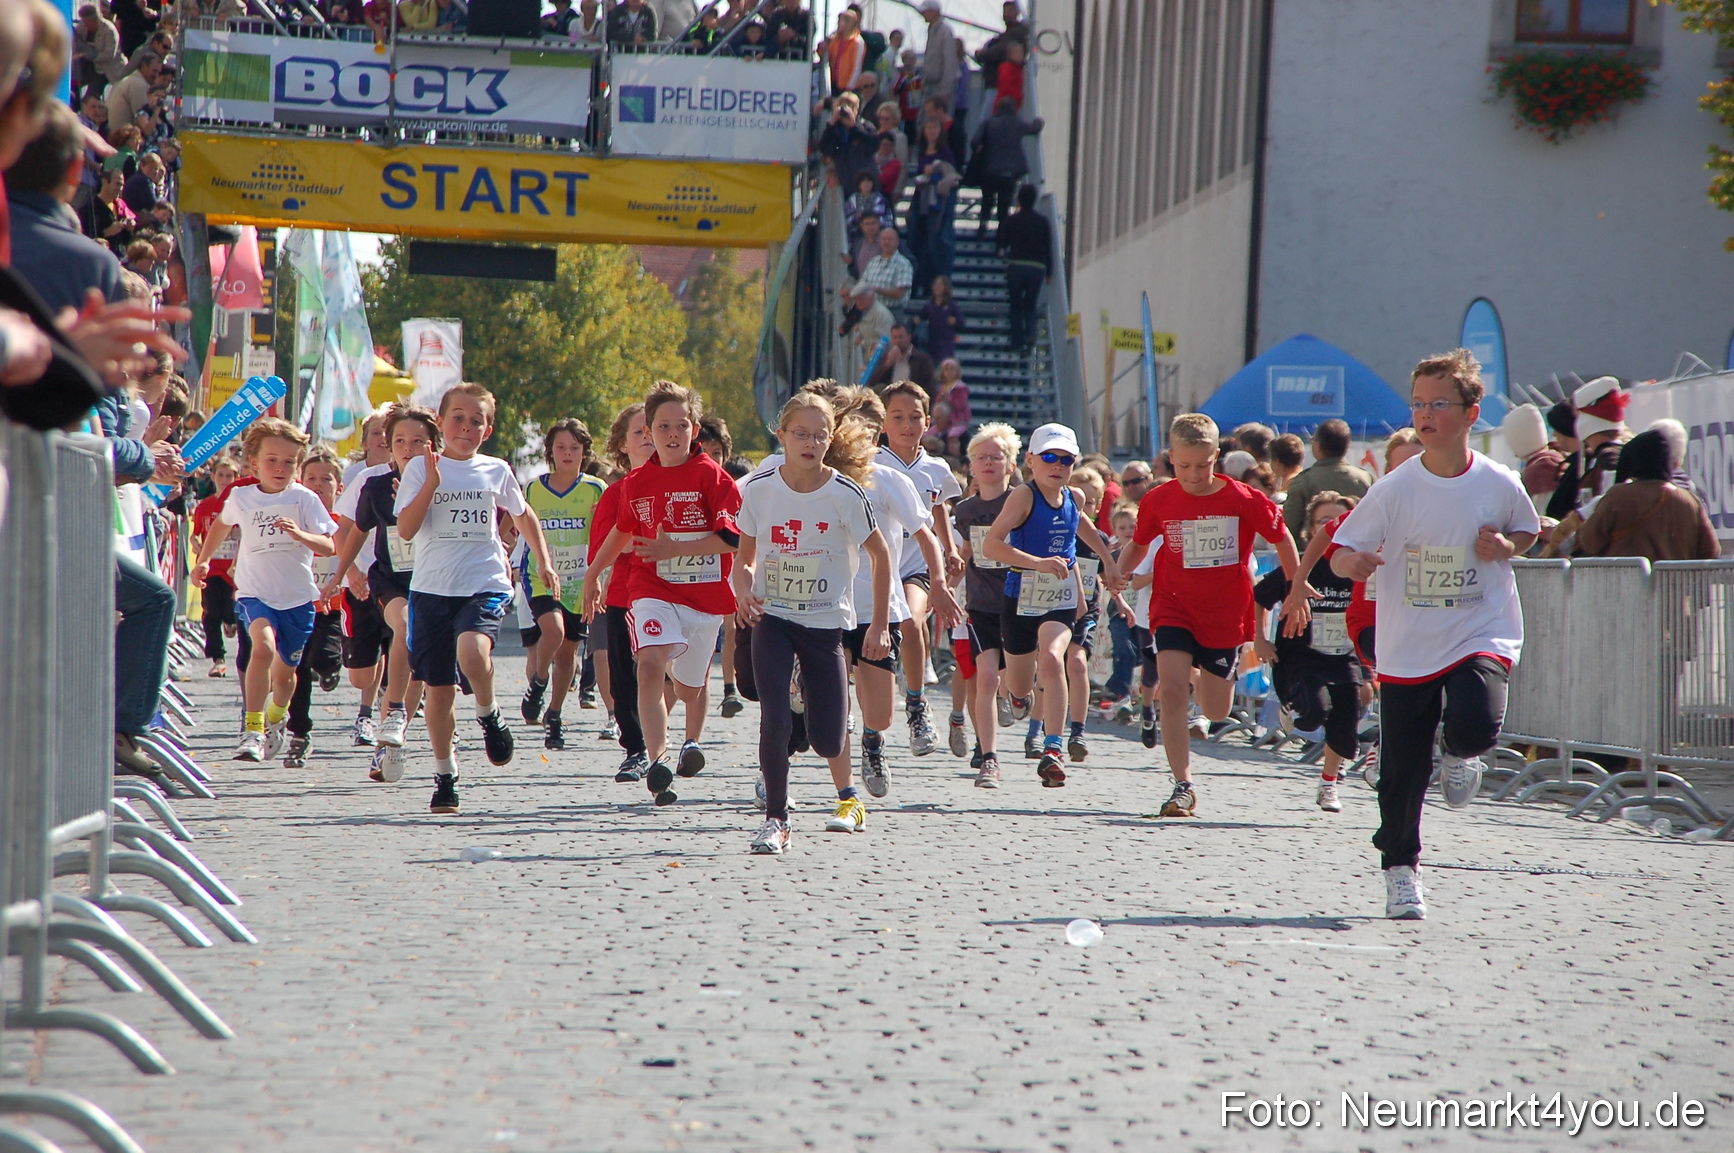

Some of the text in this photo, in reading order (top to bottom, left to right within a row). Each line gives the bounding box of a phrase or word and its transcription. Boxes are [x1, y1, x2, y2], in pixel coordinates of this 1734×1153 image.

[275, 56, 509, 115] BOCK
[661, 86, 798, 115] PFLEIDERER
[660, 114, 798, 131] AKTIENGESELLSCHAFT
[211, 176, 345, 196] Neumarkter Stadtlauf
[380, 161, 590, 217] START
[627, 199, 757, 215] Neumarkter Stadtlauf
[1276, 374, 1329, 393] maxi
[434, 491, 483, 505] DOMINIK
[251, 510, 279, 525] Alex
[450, 509, 488, 525] 7316
[540, 509, 568, 517] TEAM
[540, 518, 587, 531] BOCK
[1198, 524, 1219, 533] Henri
[1199, 536, 1236, 552] 7092
[555, 549, 570, 557] Luca
[1424, 550, 1454, 564] Anton
[556, 557, 585, 571] 7232
[783, 561, 805, 573] Anna
[784, 577, 828, 594] 7170
[1426, 568, 1478, 588] 7252
[1037, 588, 1073, 602] 7249
[645, 626, 661, 634] FCN
